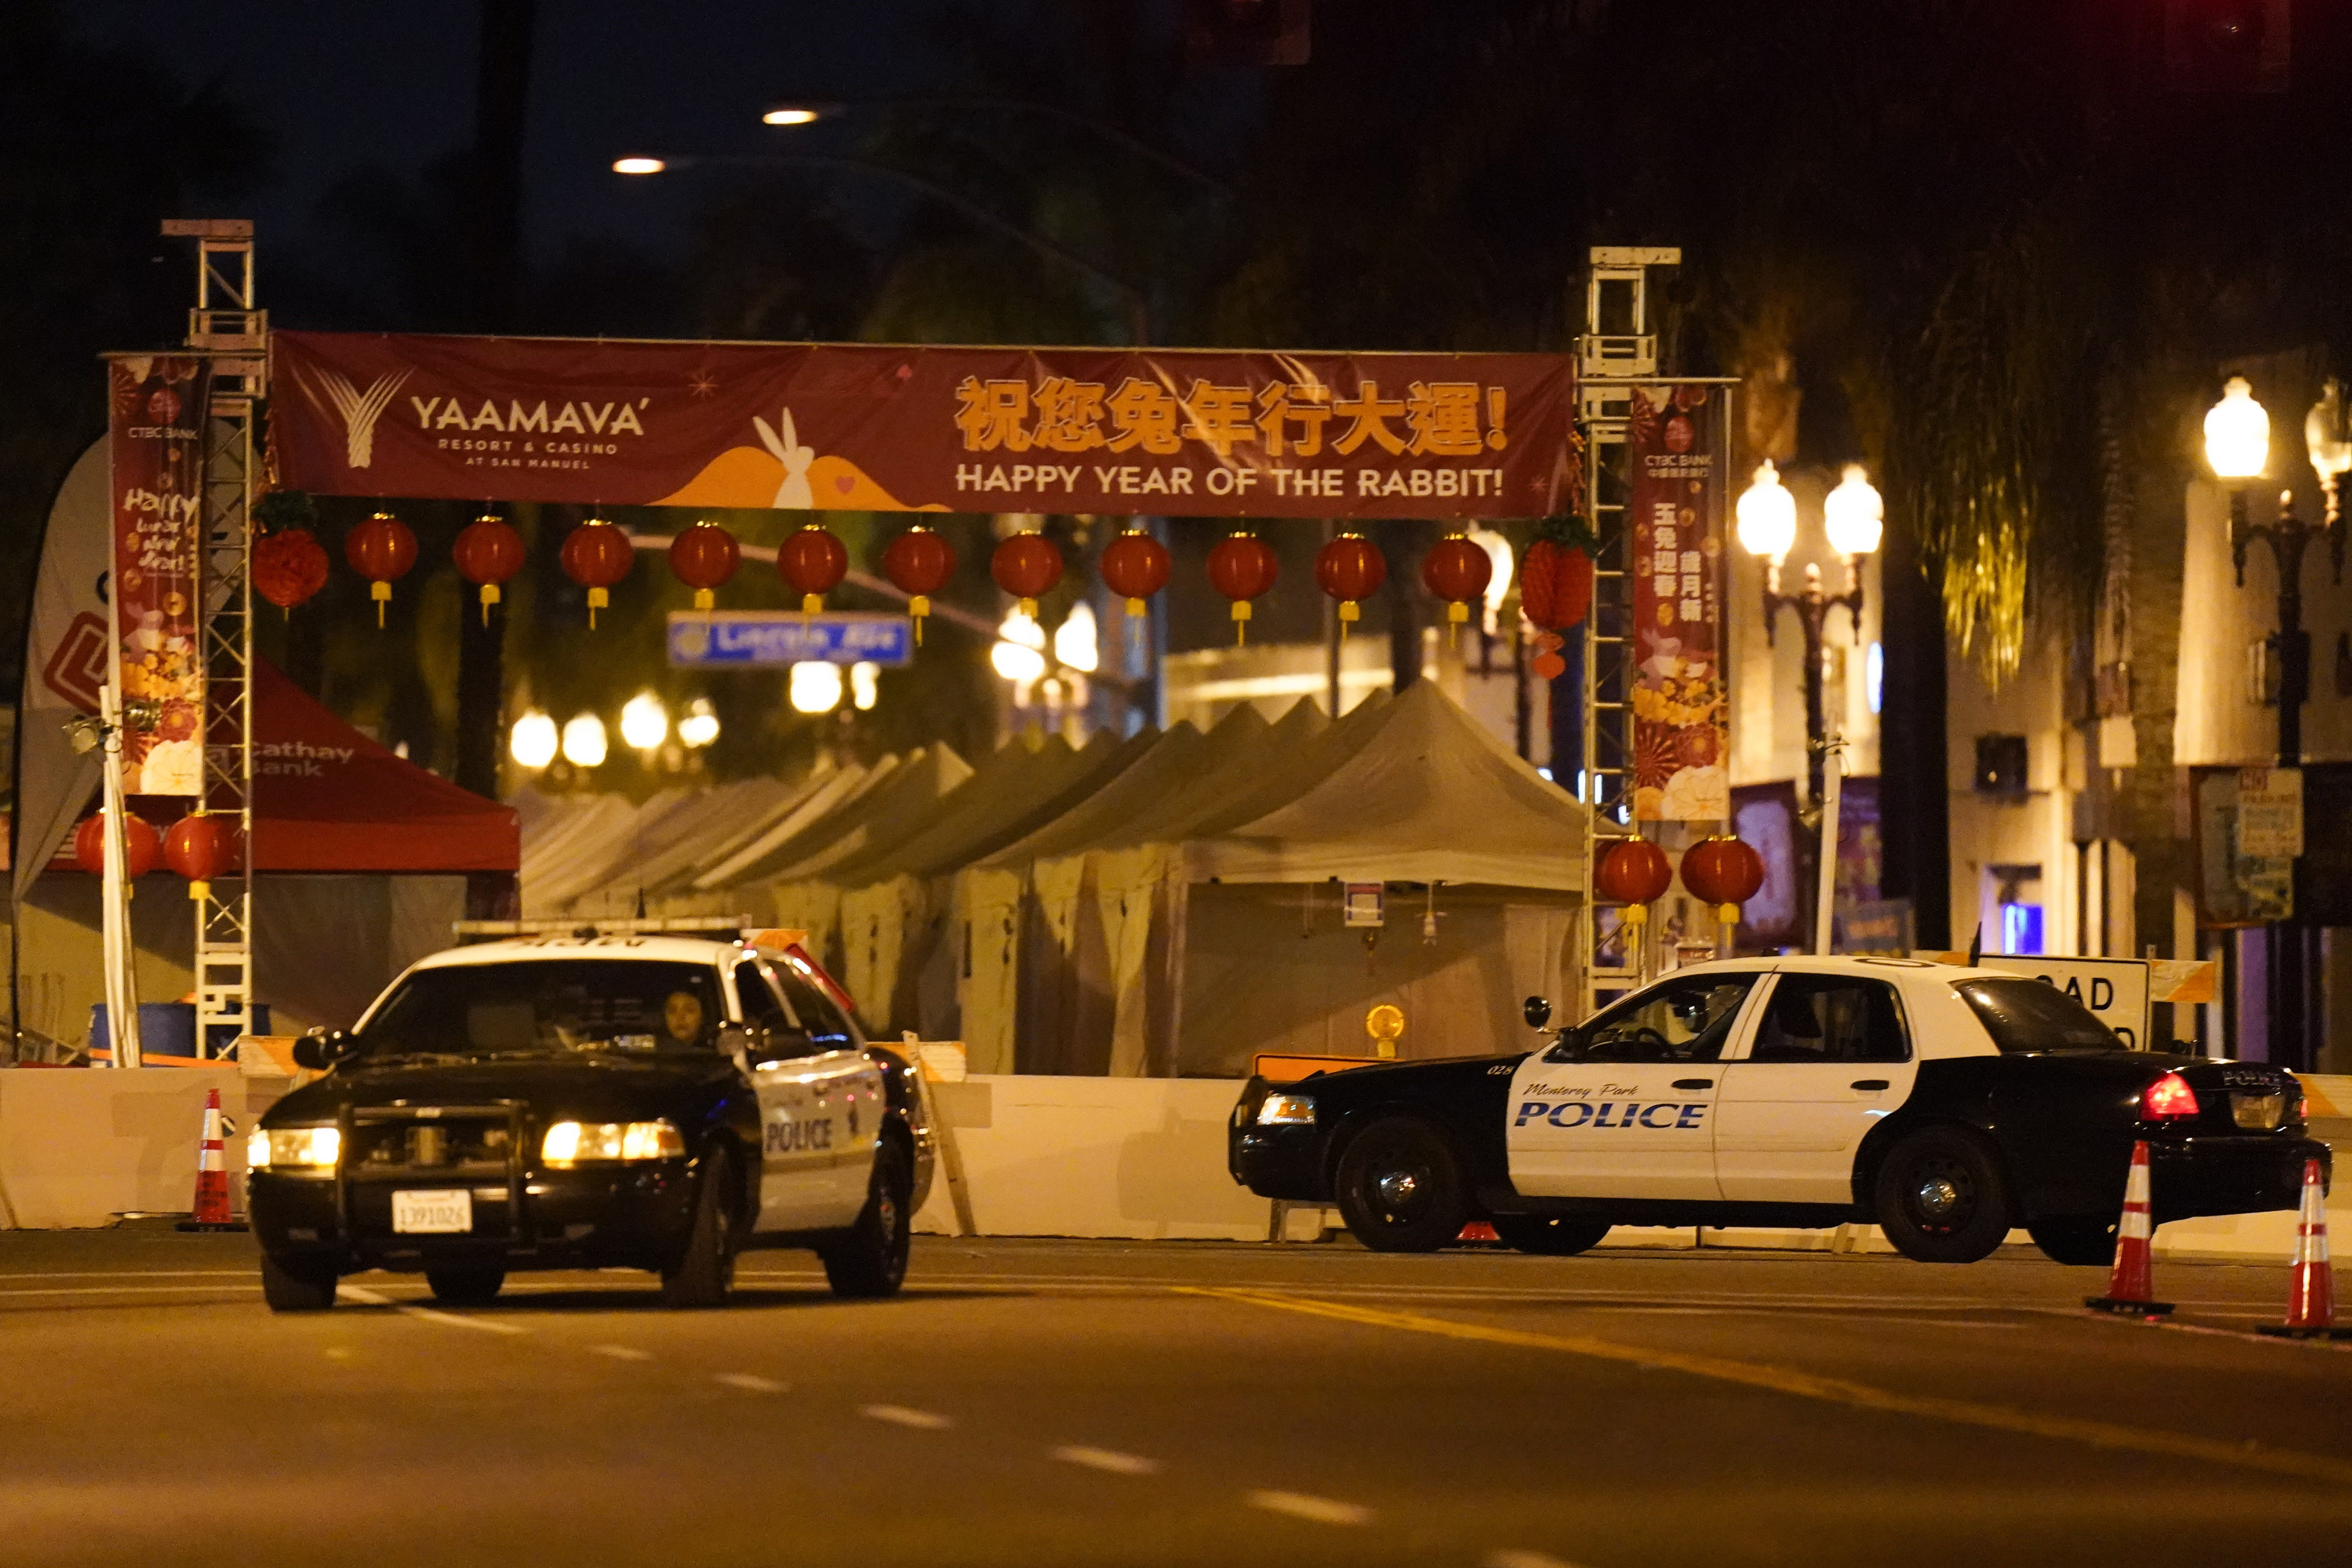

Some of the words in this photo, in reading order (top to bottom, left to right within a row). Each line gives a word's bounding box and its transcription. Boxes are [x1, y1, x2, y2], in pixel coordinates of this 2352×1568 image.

[438, 439, 513, 452] RESORT
[524, 442, 534, 452] &
[545, 442, 618, 455] CASINO
[466, 457, 483, 466] AT
[491, 457, 521, 467] SAN
[528, 458, 590, 470] MANUEL
[956, 463, 1083, 493] HAPPY
[1094, 466, 1193, 495] YEAR
[1206, 467, 1257, 496] OF
[1271, 469, 1344, 496] THE
[1358, 469, 1503, 496] RABBIT!
[1523, 1083, 1592, 1100] Monterey
[1600, 1083, 1639, 1096] Park
[1514, 1102, 1708, 1129] POLICE
[765, 1117, 833, 1153] POLICE
